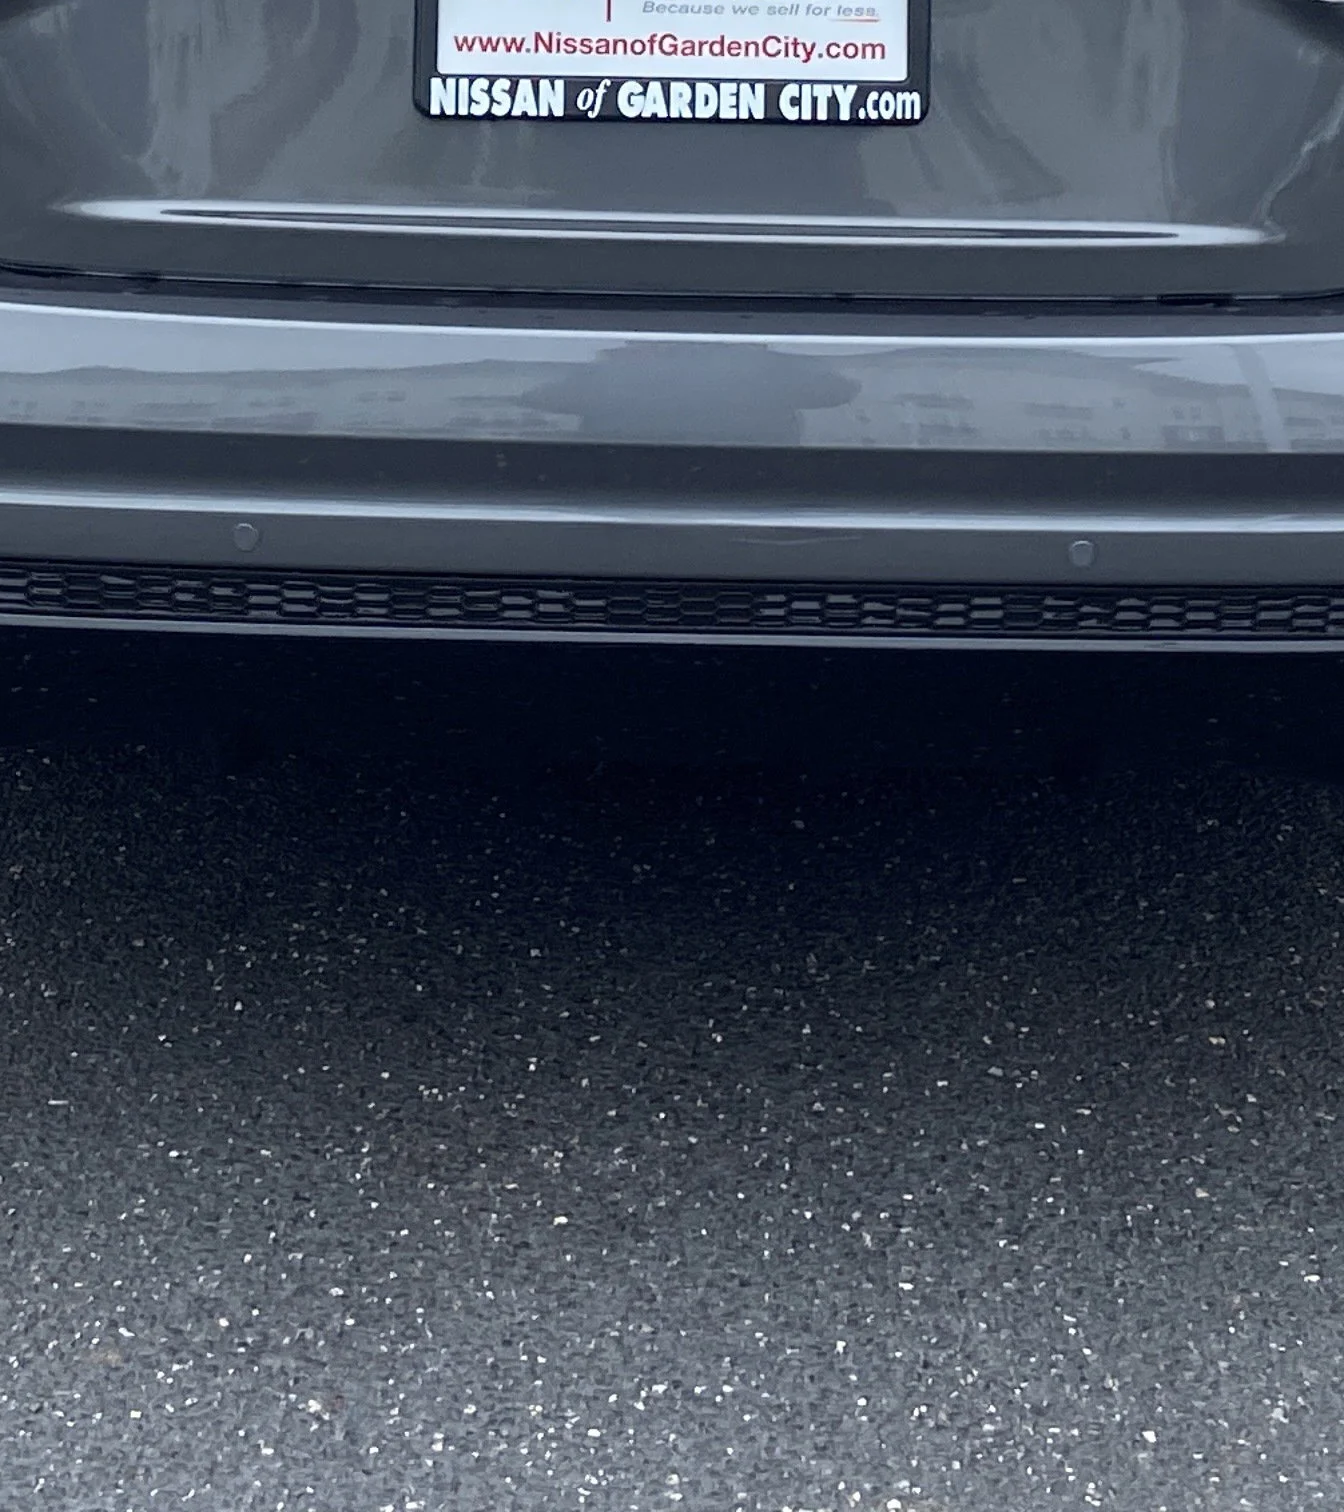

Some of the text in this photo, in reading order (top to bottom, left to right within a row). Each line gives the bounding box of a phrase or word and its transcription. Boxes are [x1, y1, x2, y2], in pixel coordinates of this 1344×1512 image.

[642, 0, 725, 15] Because
[732, 5, 760, 16] we
[767, 3, 800, 16] sell
[805, 3, 832, 17] for
[453, 31, 886, 64] www.NissanofGardenCity.com
[429, 77, 921, 121] NISSAN of GARDEN CITY.com
